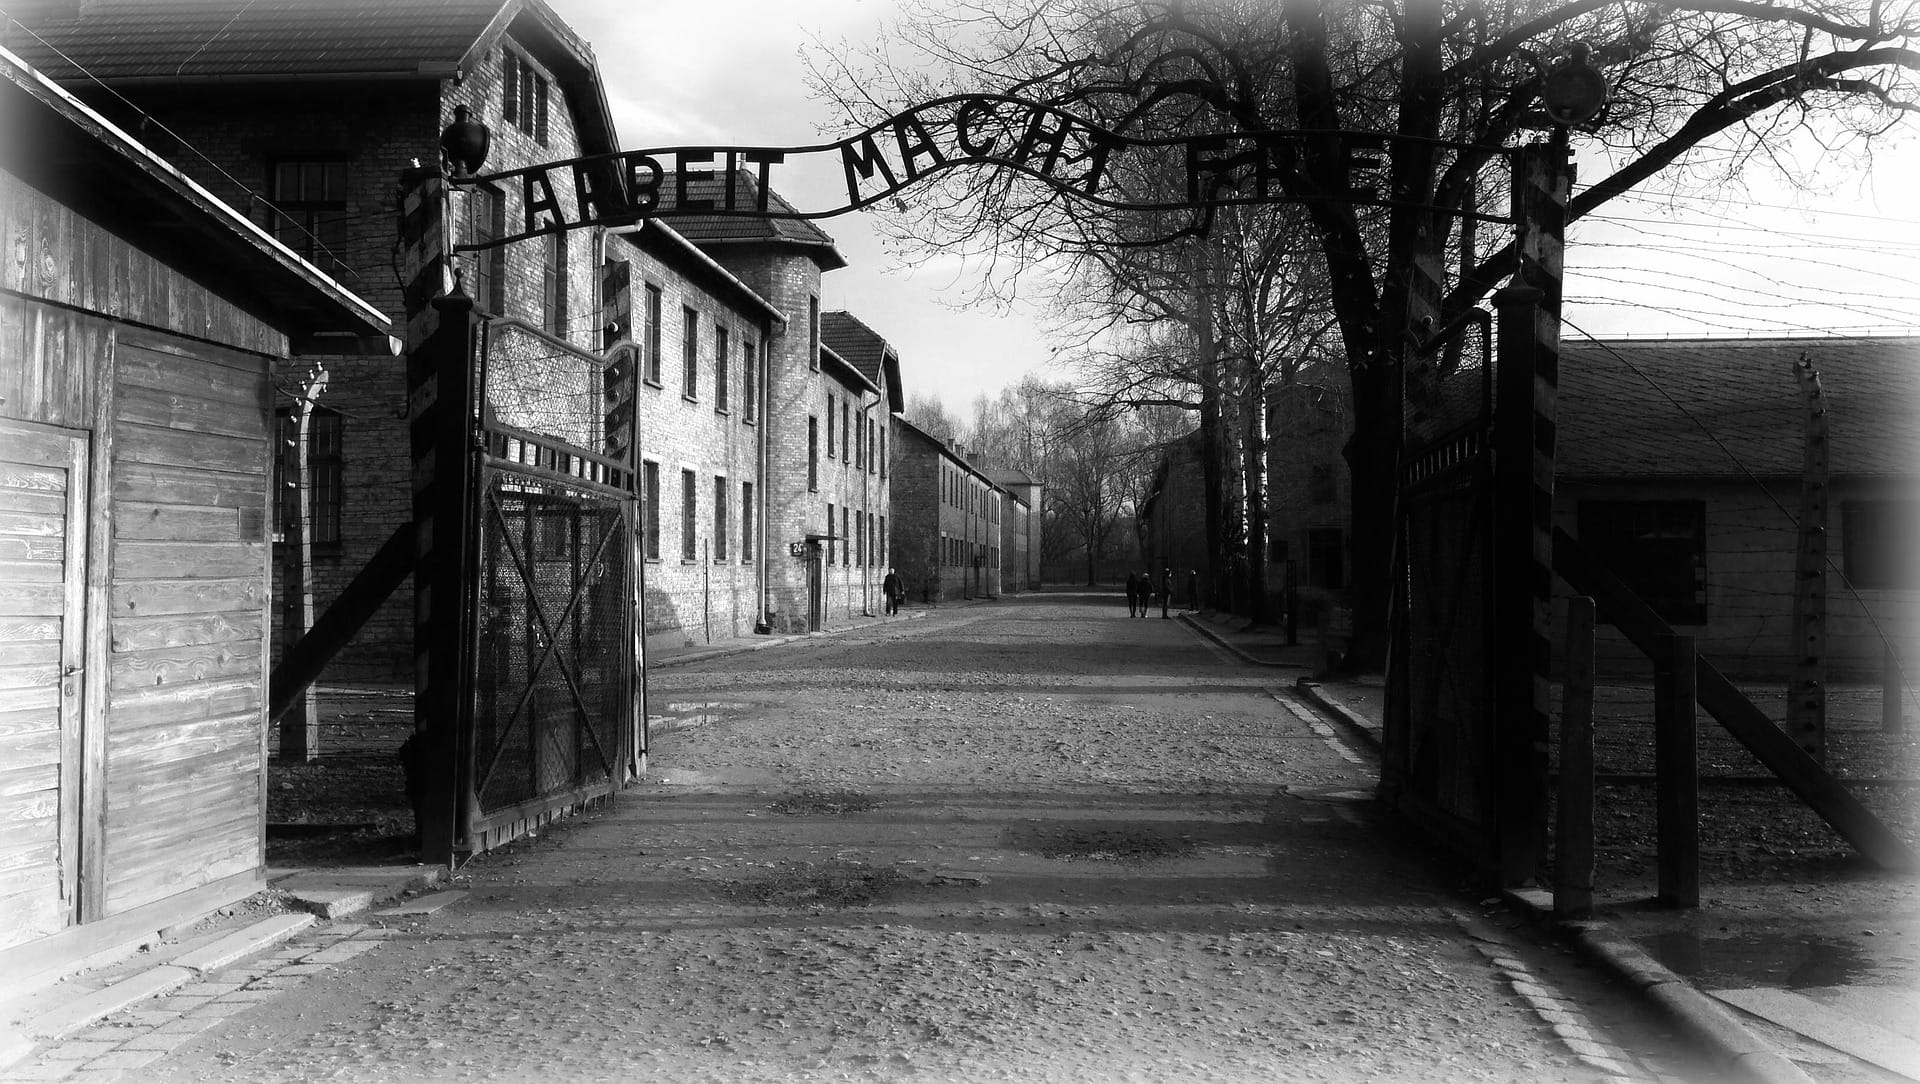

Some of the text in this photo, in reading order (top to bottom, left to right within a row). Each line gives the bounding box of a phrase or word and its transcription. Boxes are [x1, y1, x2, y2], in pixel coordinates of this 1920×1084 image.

[523, 100, 1395, 233] ARBEIT MACHT FRE
